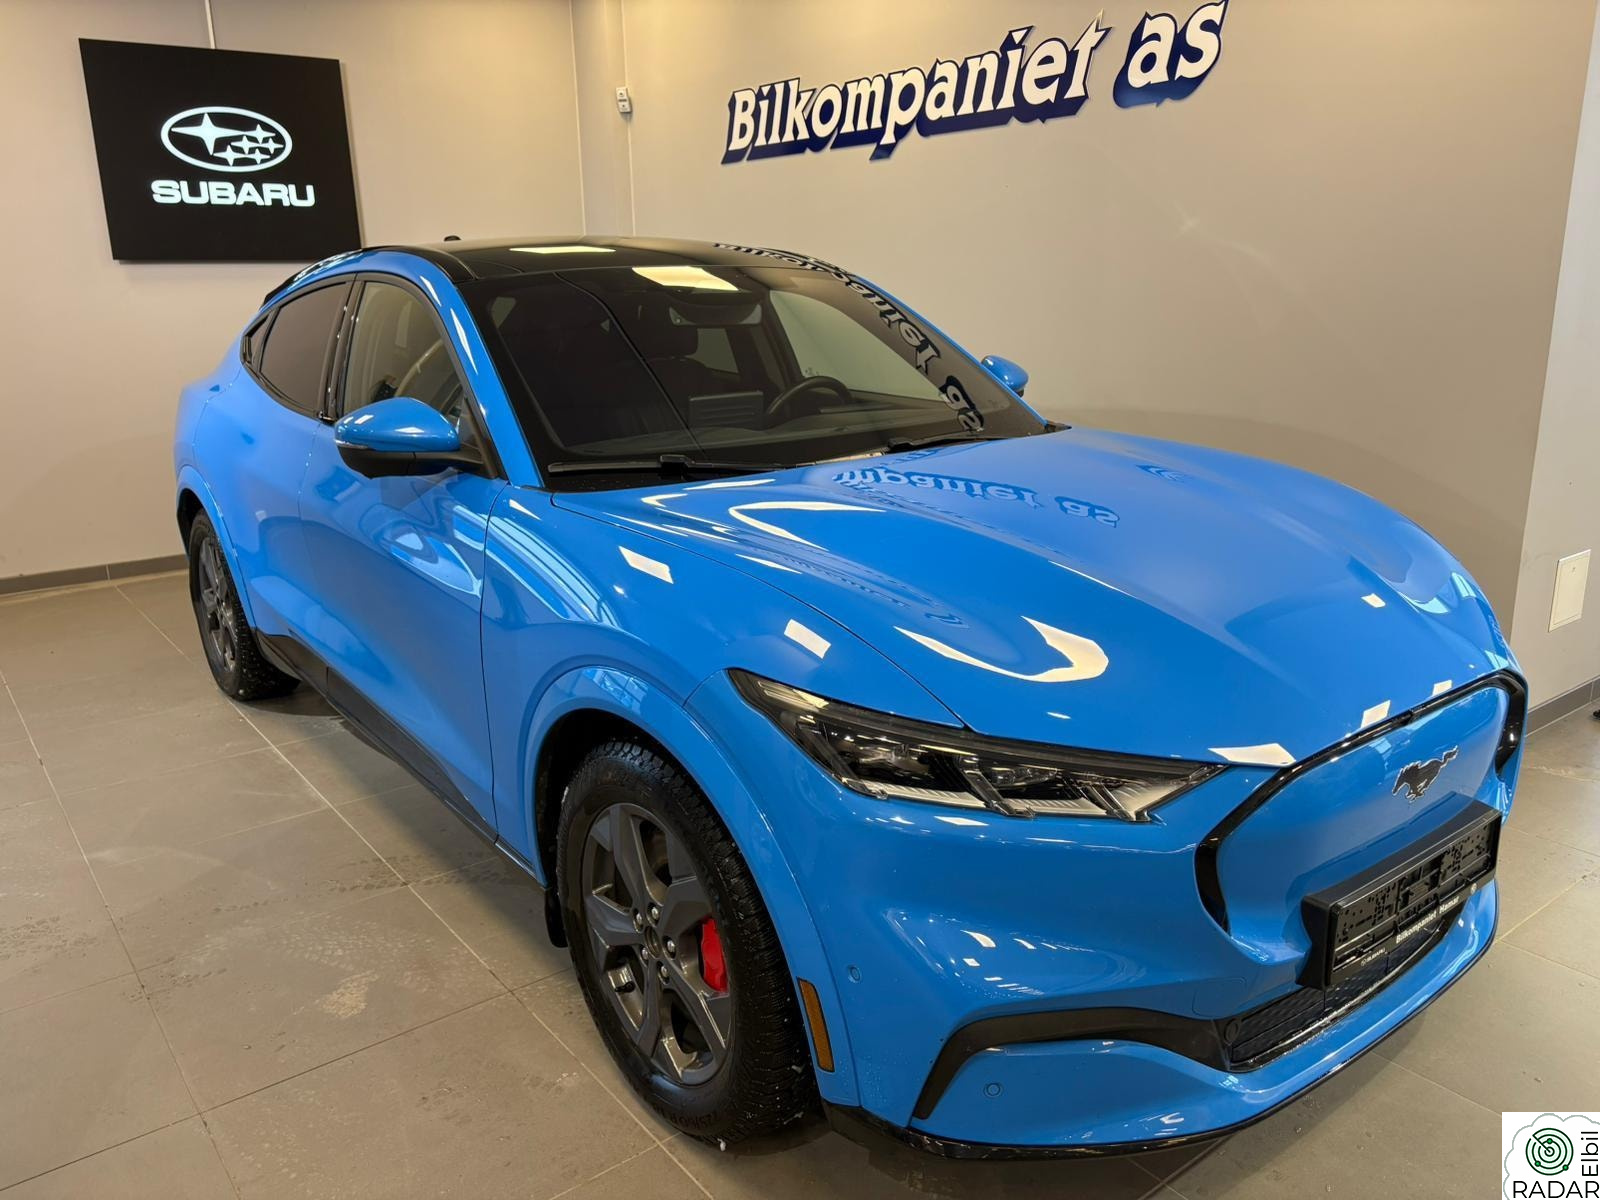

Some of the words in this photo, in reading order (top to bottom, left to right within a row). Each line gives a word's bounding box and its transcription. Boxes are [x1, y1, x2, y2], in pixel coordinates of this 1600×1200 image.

[722, 12, 1112, 164] Bilkompaniet
[1114, 0, 1229, 106] as
[150, 180, 316, 207] SUBARU
